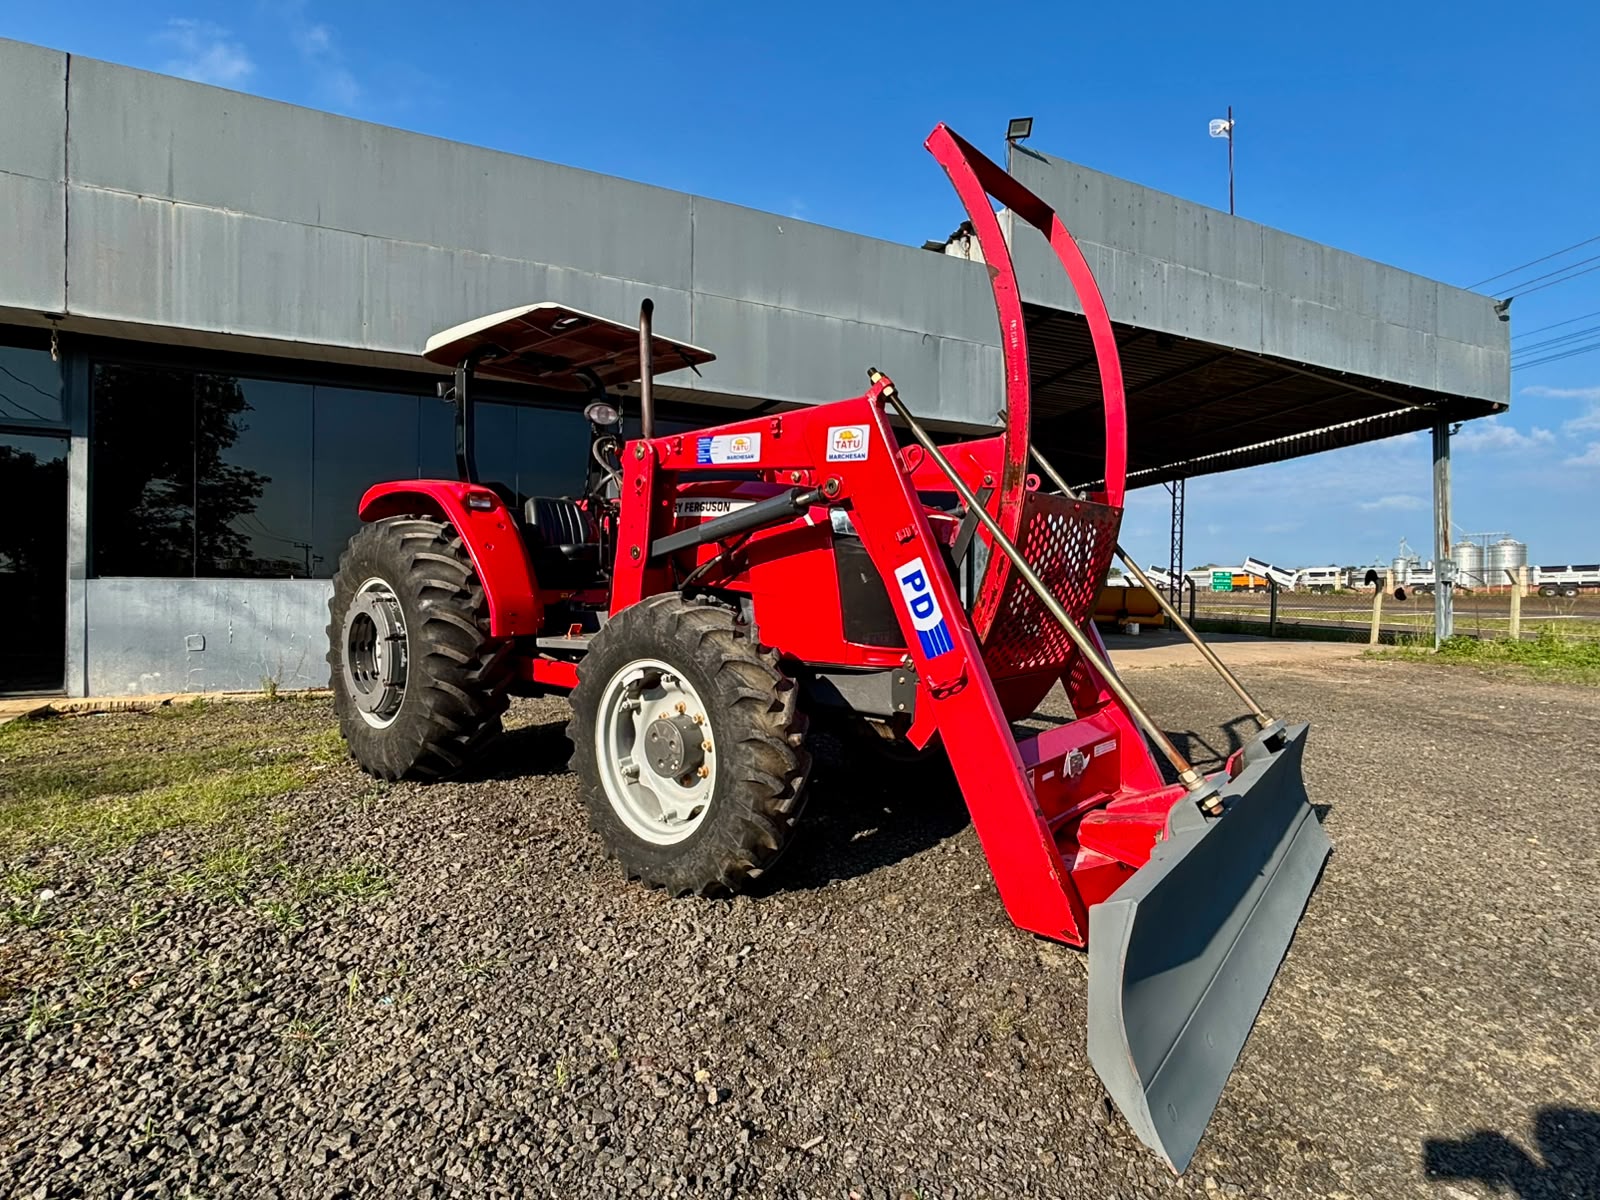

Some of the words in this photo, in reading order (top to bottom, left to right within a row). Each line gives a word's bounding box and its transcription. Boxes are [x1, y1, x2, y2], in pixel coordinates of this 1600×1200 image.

[835, 440, 860, 449] TATU
[684, 501, 731, 512] FERGUSON
[901, 569, 934, 619] PD
